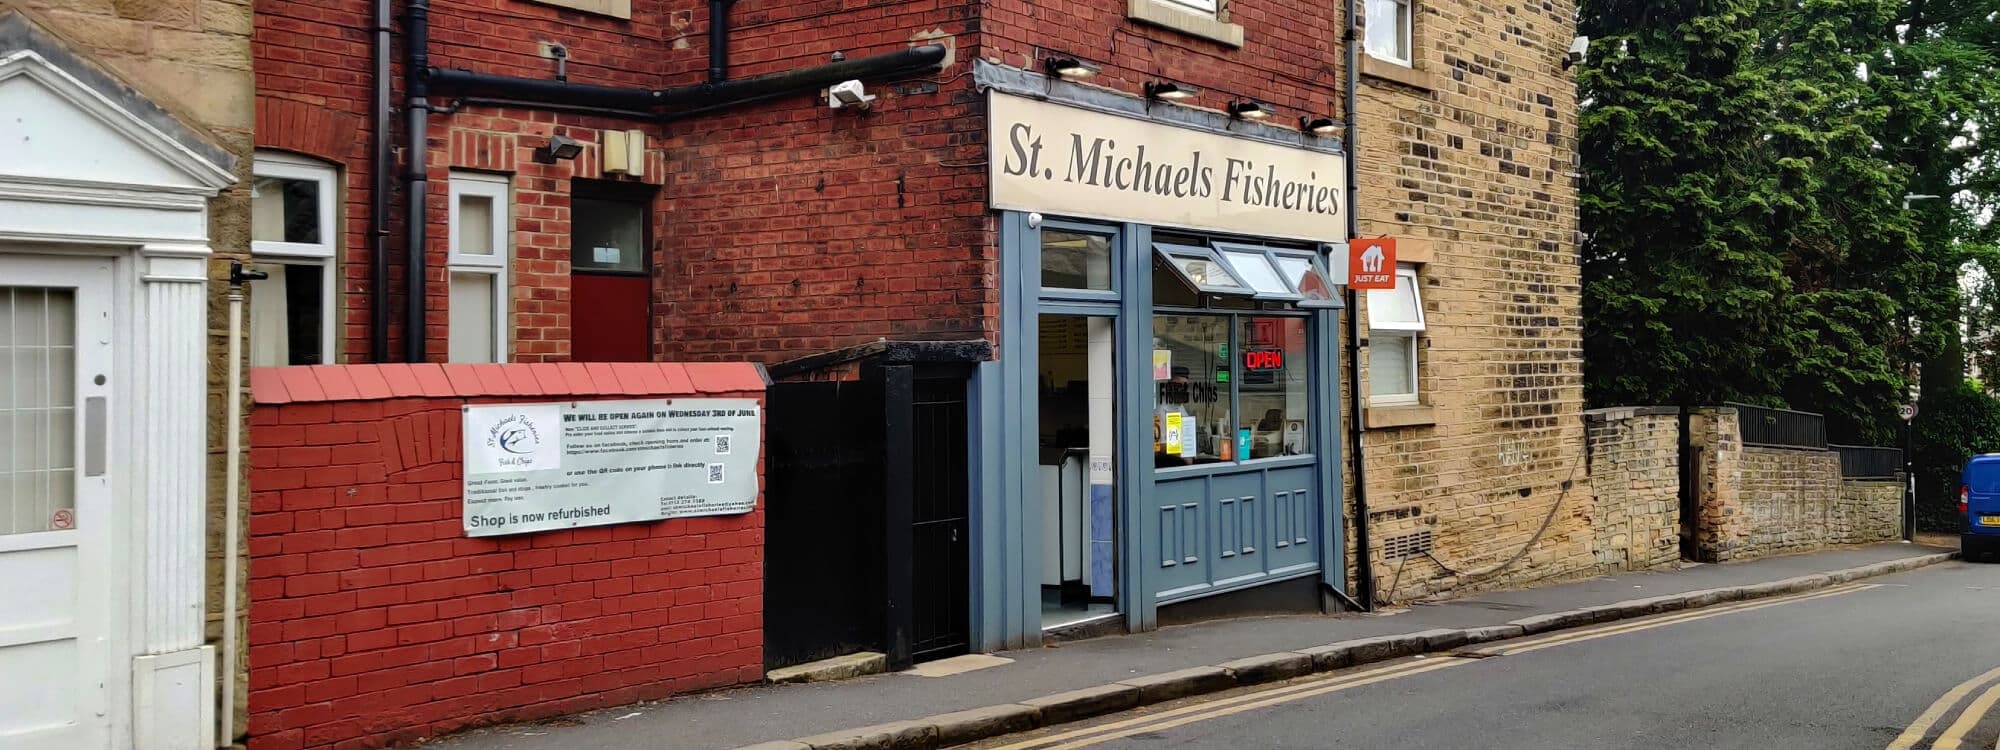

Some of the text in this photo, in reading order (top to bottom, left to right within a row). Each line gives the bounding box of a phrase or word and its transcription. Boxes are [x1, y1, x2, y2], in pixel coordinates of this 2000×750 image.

[1003, 122, 1340, 216] St. Michaels Fisheries
[1354, 274, 1390, 284] JUST EAT
[1246, 351, 1281, 369] OPEN
[563, 413, 576, 422] WE
[578, 413, 596, 421] WILL
[609, 412, 629, 420] OPEN
[631, 411, 654, 419] AGAIN
[668, 409, 711, 418] WEDNESDAY
[712, 409, 726, 417] 3RD
[727, 409, 736, 417] OF
[737, 409, 756, 417] JUNE
[1899, 407, 1913, 415] 20
[470, 504, 611, 528] Shop is now refurbished
